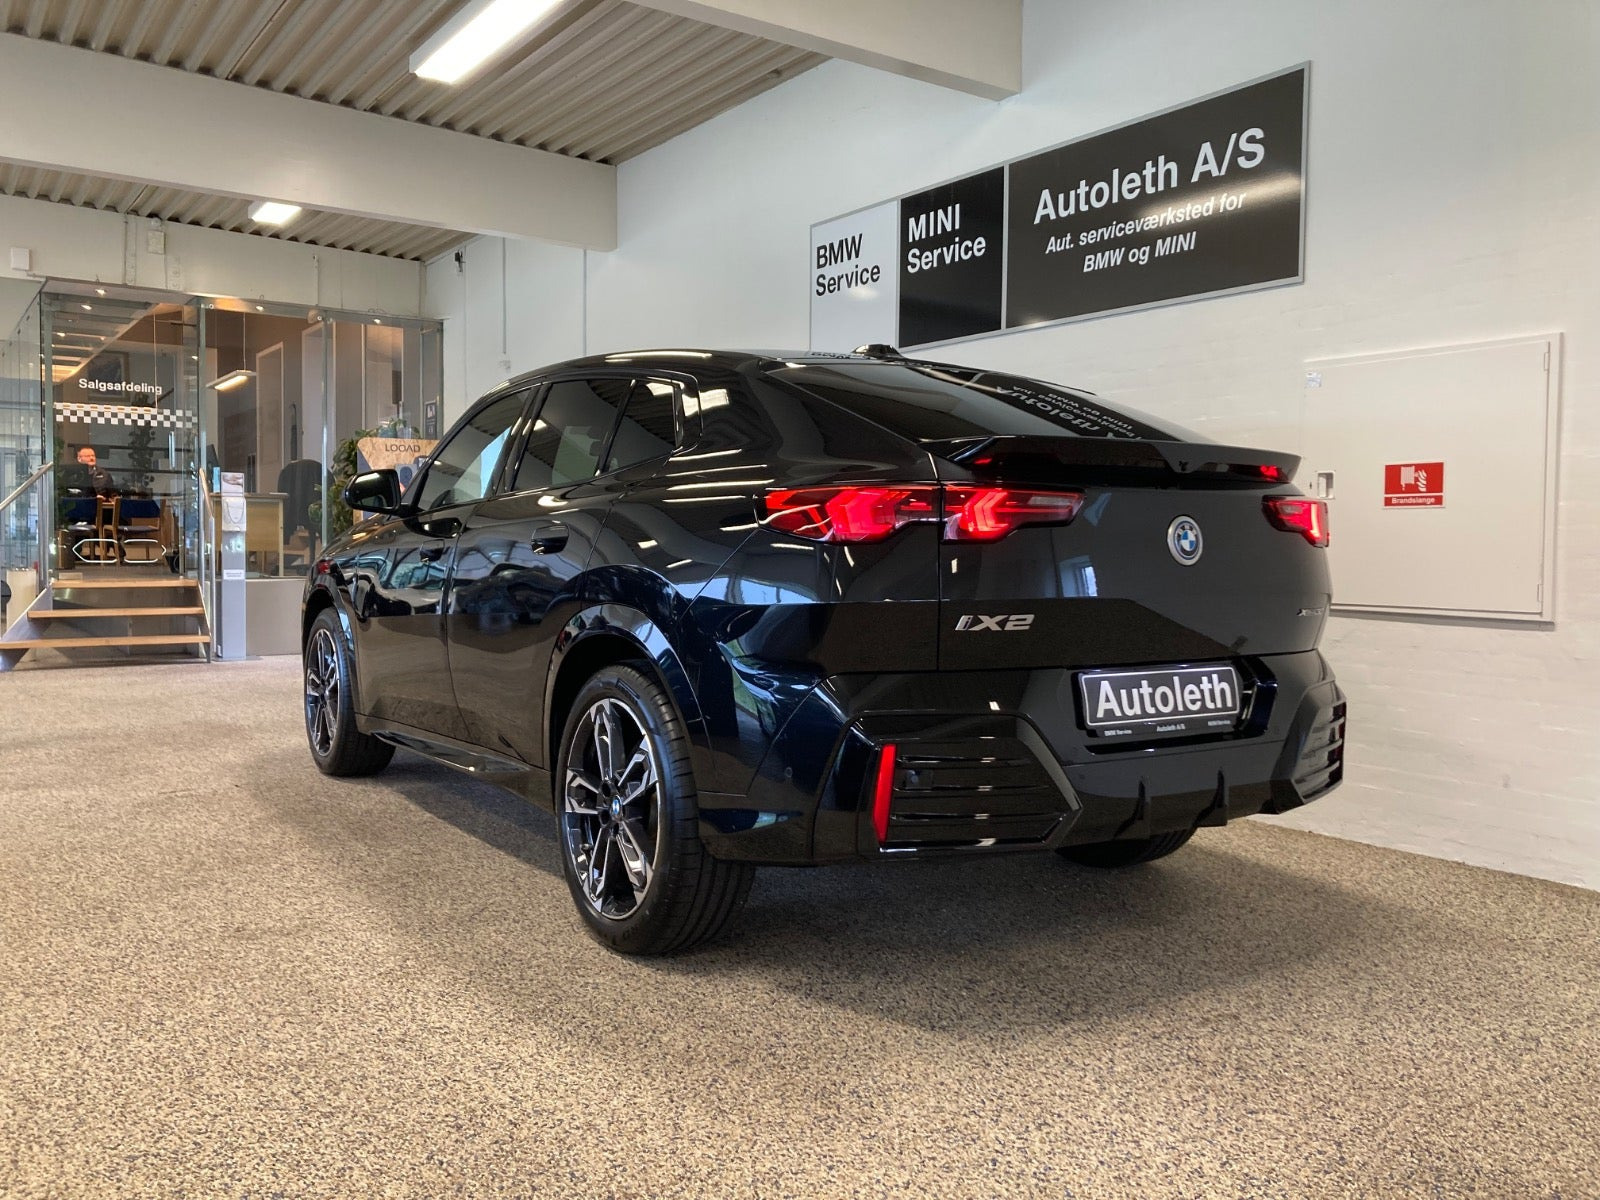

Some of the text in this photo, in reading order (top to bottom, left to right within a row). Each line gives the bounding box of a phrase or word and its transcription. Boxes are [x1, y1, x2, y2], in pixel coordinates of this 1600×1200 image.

[1033, 127, 1265, 225] Autoleth A/S
[908, 203, 960, 243] MINI
[1045, 193, 1247, 254] Aut. serviceværksted for
[816, 233, 863, 269] BMW
[907, 236, 986, 274] Service
[1083, 231, 1197, 272] BMW og MINI
[815, 264, 881, 297] Service
[79, 378, 163, 395] Salgsafdeling
[1391, 497, 1435, 505] Brandslange
[955, 614, 1035, 631] iX2
[1096, 673, 1233, 719] Autoleth
